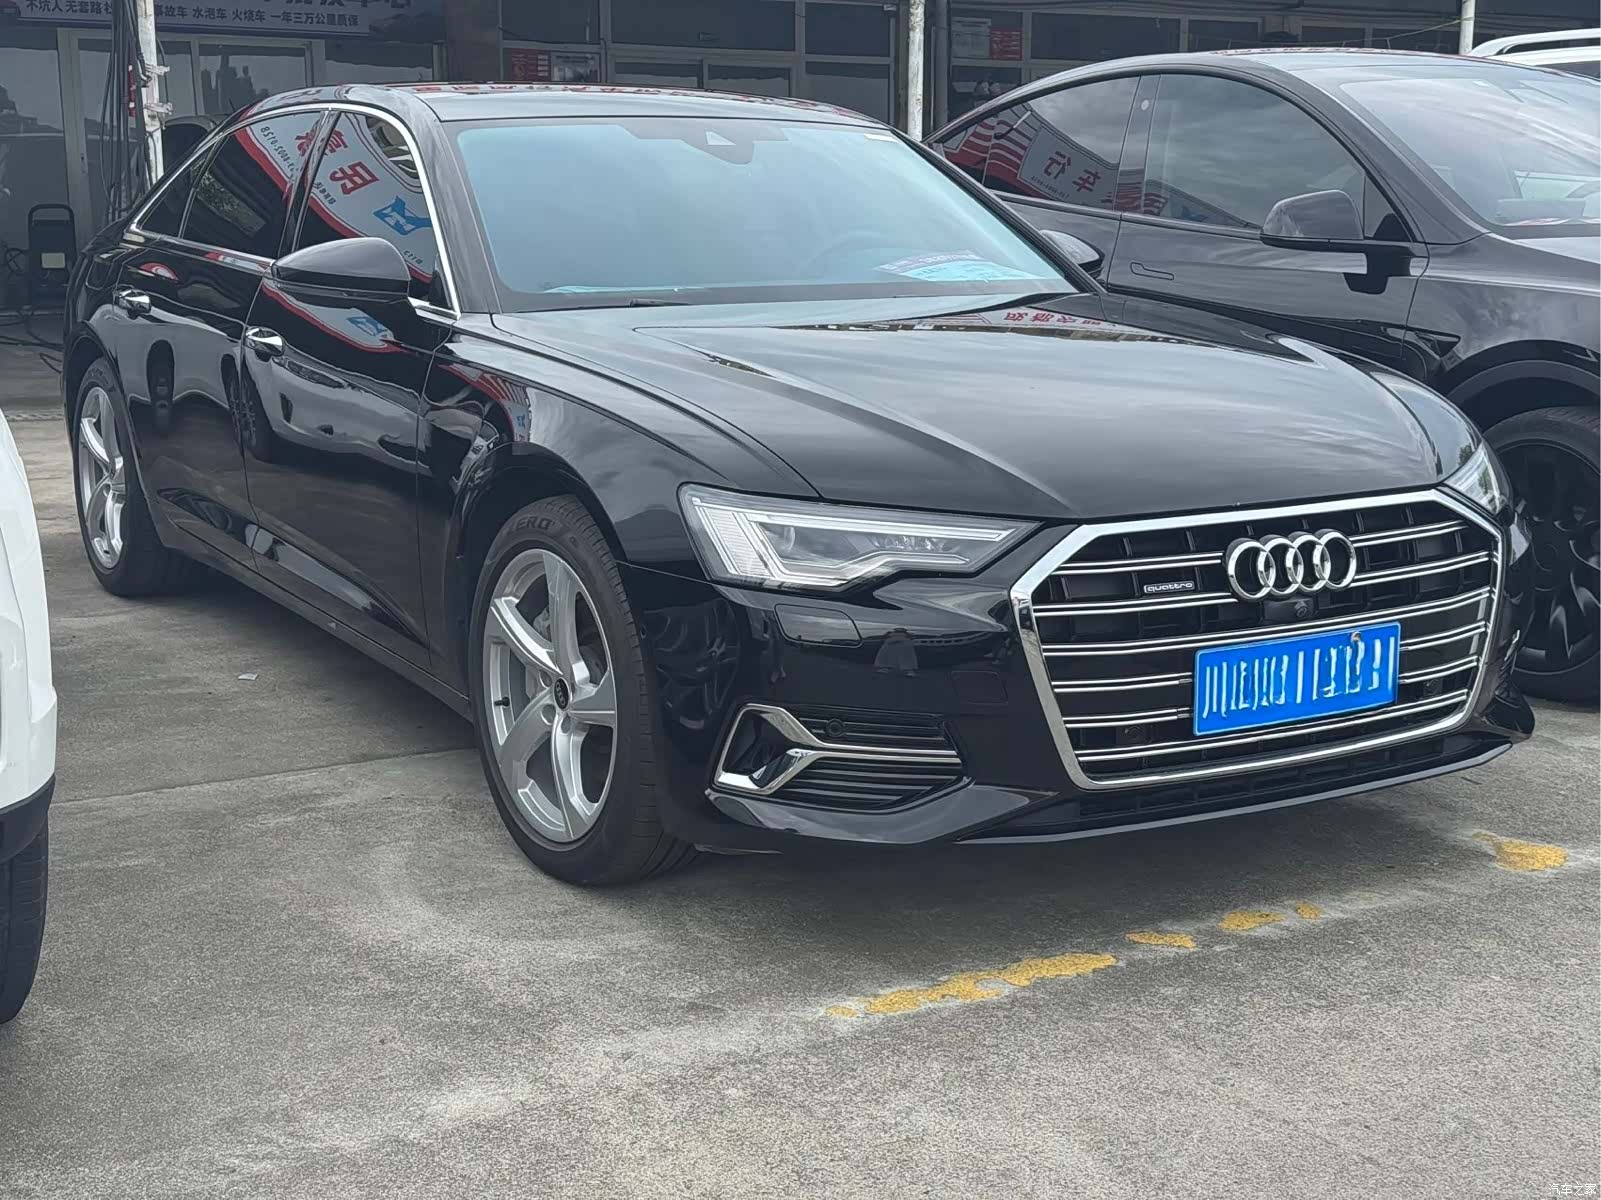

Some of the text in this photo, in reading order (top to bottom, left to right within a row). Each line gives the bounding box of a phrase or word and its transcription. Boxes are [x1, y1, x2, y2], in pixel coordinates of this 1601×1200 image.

[26, 0, 63, 13] 不坑人
[65, 1, 101, 15] 无套路
[232, 8, 267, 23] 火烧车
[1147, 582, 1193, 592] quattro
